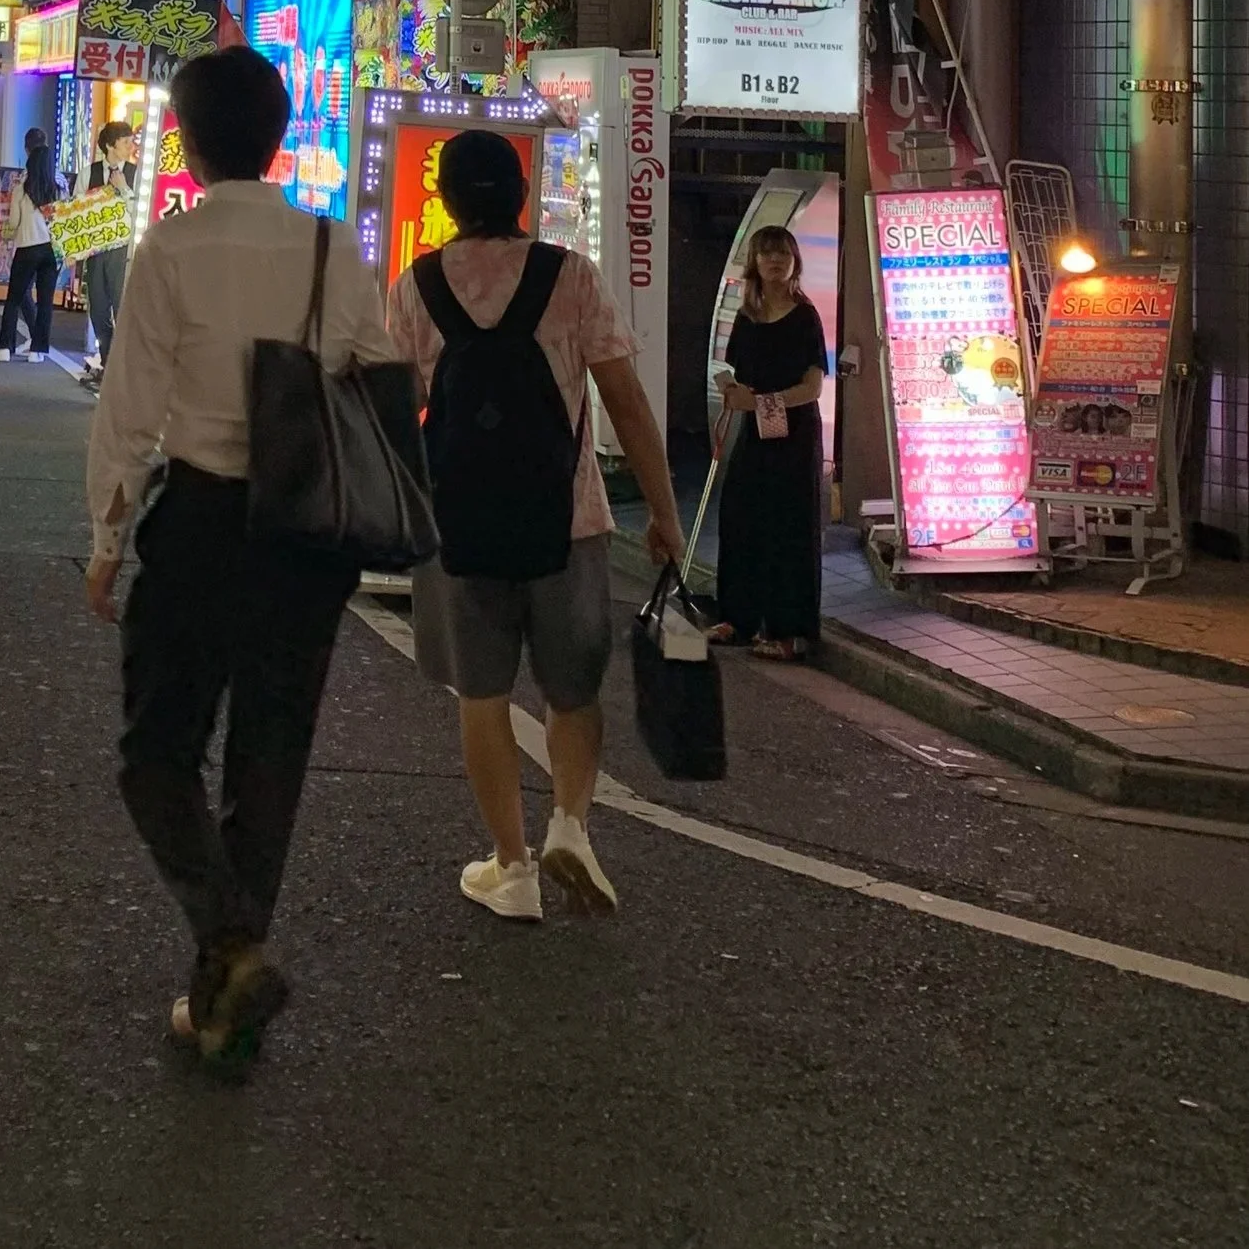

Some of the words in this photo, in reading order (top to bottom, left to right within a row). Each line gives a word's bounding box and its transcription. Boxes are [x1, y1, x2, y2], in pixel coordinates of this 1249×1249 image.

[741, 7, 764, 19] CLUB
[778, 9, 798, 21] BAR
[786, 28, 805, 37] MIX
[697, 37, 710, 45] HIP
[712, 37, 728, 46] HOP
[758, 40, 788, 49] REGGAE
[794, 42, 818, 50] DANCE
[820, 42, 844, 51] MUSIC
[81, 41, 146, 78] 受付
[741, 74, 760, 92] B1
[765, 79, 775, 92] &
[778, 76, 800, 94] B2
[761, 95, 779, 105] Floor
[882, 201, 926, 219] Family
[929, 200, 994, 216] Restaurant
[51, 202, 126, 240] すぐ入れます
[62, 222, 130, 256] 受付こちら
[886, 223, 1000, 249] SPECIAL
[889, 257, 962, 269] ファミリーレストラン
[969, 254, 1003, 264] スペシャル
[1063, 296, 1161, 316] SPECIAL
[1041, 467, 1068, 477] VISA
[1121, 463, 1147, 482] 2F
[912, 529, 935, 546] 2F
